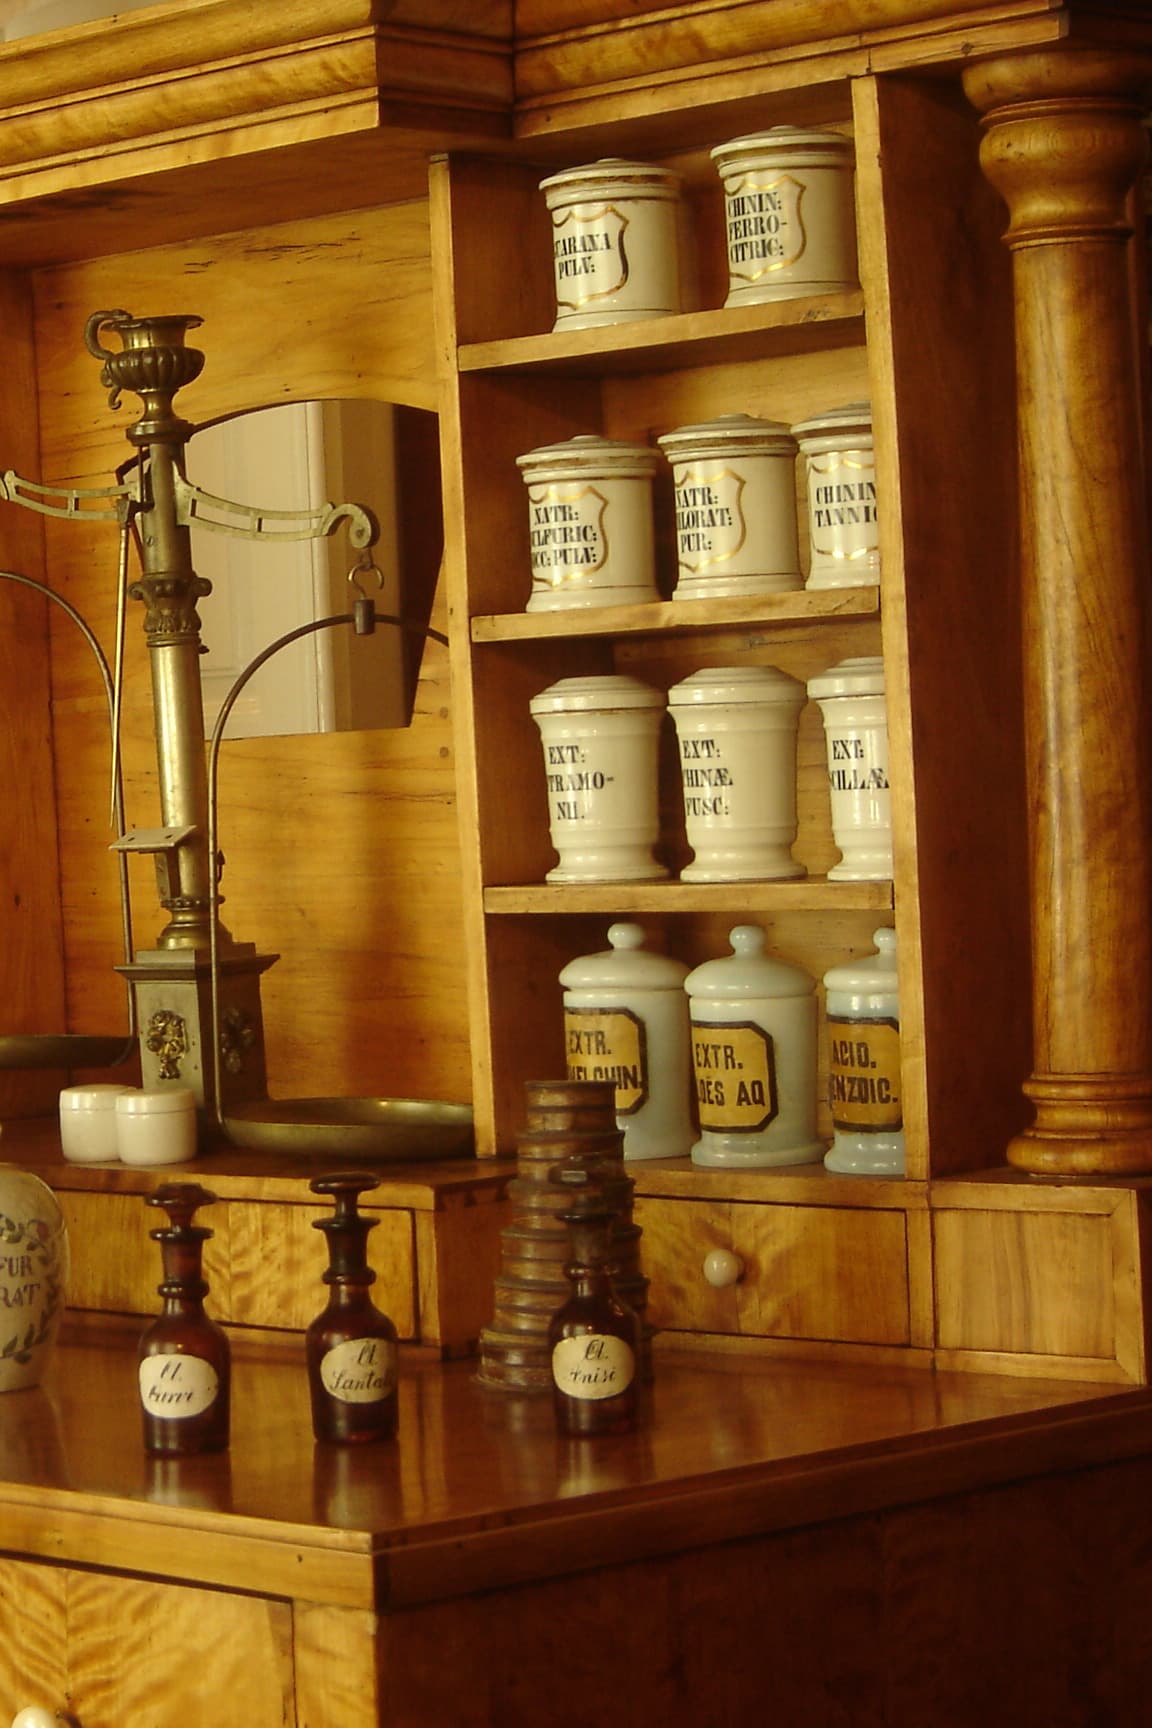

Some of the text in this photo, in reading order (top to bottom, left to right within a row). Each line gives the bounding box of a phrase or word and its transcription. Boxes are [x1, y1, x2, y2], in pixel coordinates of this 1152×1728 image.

[677, 507, 733, 531] LORAT:
[531, 525, 597, 547] LFURIC:
[548, 745, 585, 765] EXT:
[682, 739, 721, 759] EXT:
[547, 771, 615, 793] TRAMO-
[695, 1043, 744, 1070] EXTR.
[832, 1074, 899, 1104] ENZOIC.
